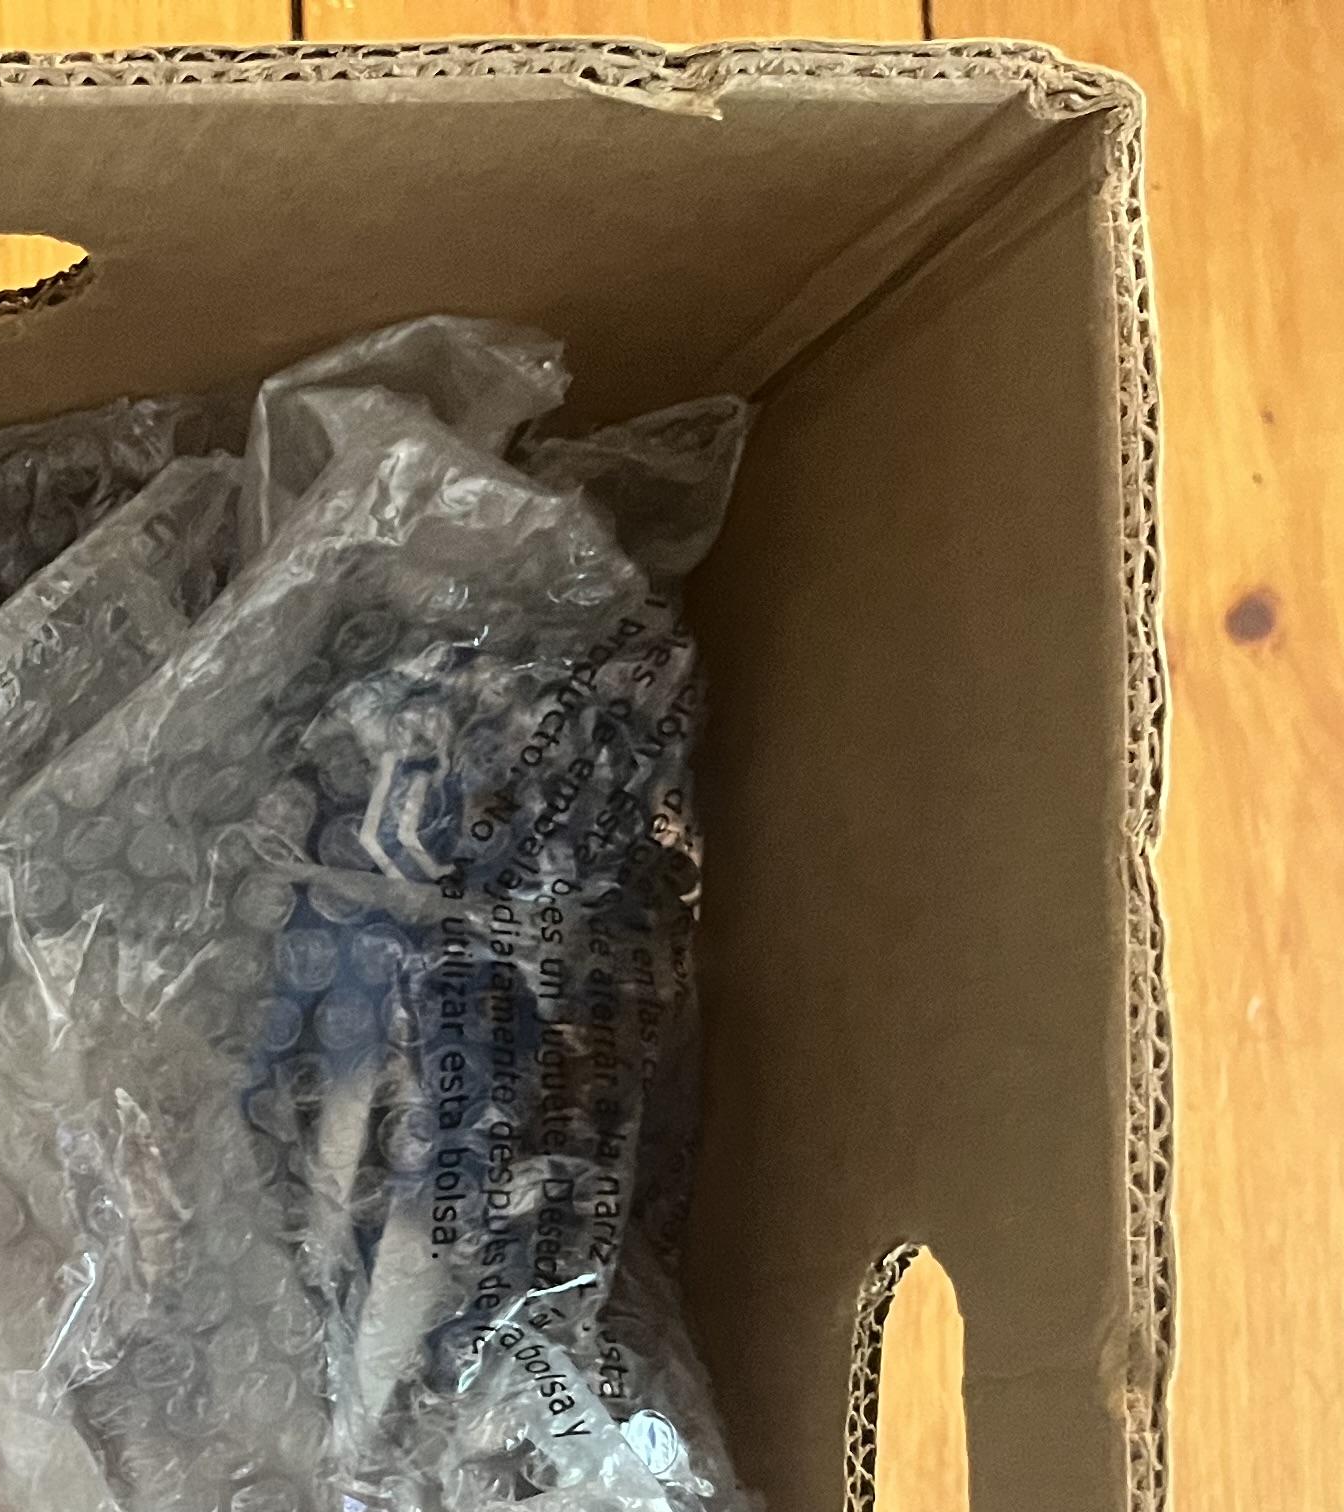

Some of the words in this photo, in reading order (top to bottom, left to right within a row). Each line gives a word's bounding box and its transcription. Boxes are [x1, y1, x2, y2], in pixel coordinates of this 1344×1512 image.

[537, 957, 568, 1001] un
[436, 1051, 467, 1130] esta
[429, 1148, 471, 1259] bolsa.
[588, 1175, 621, 1266] nariz
[513, 1345, 575, 1417] bolsa
